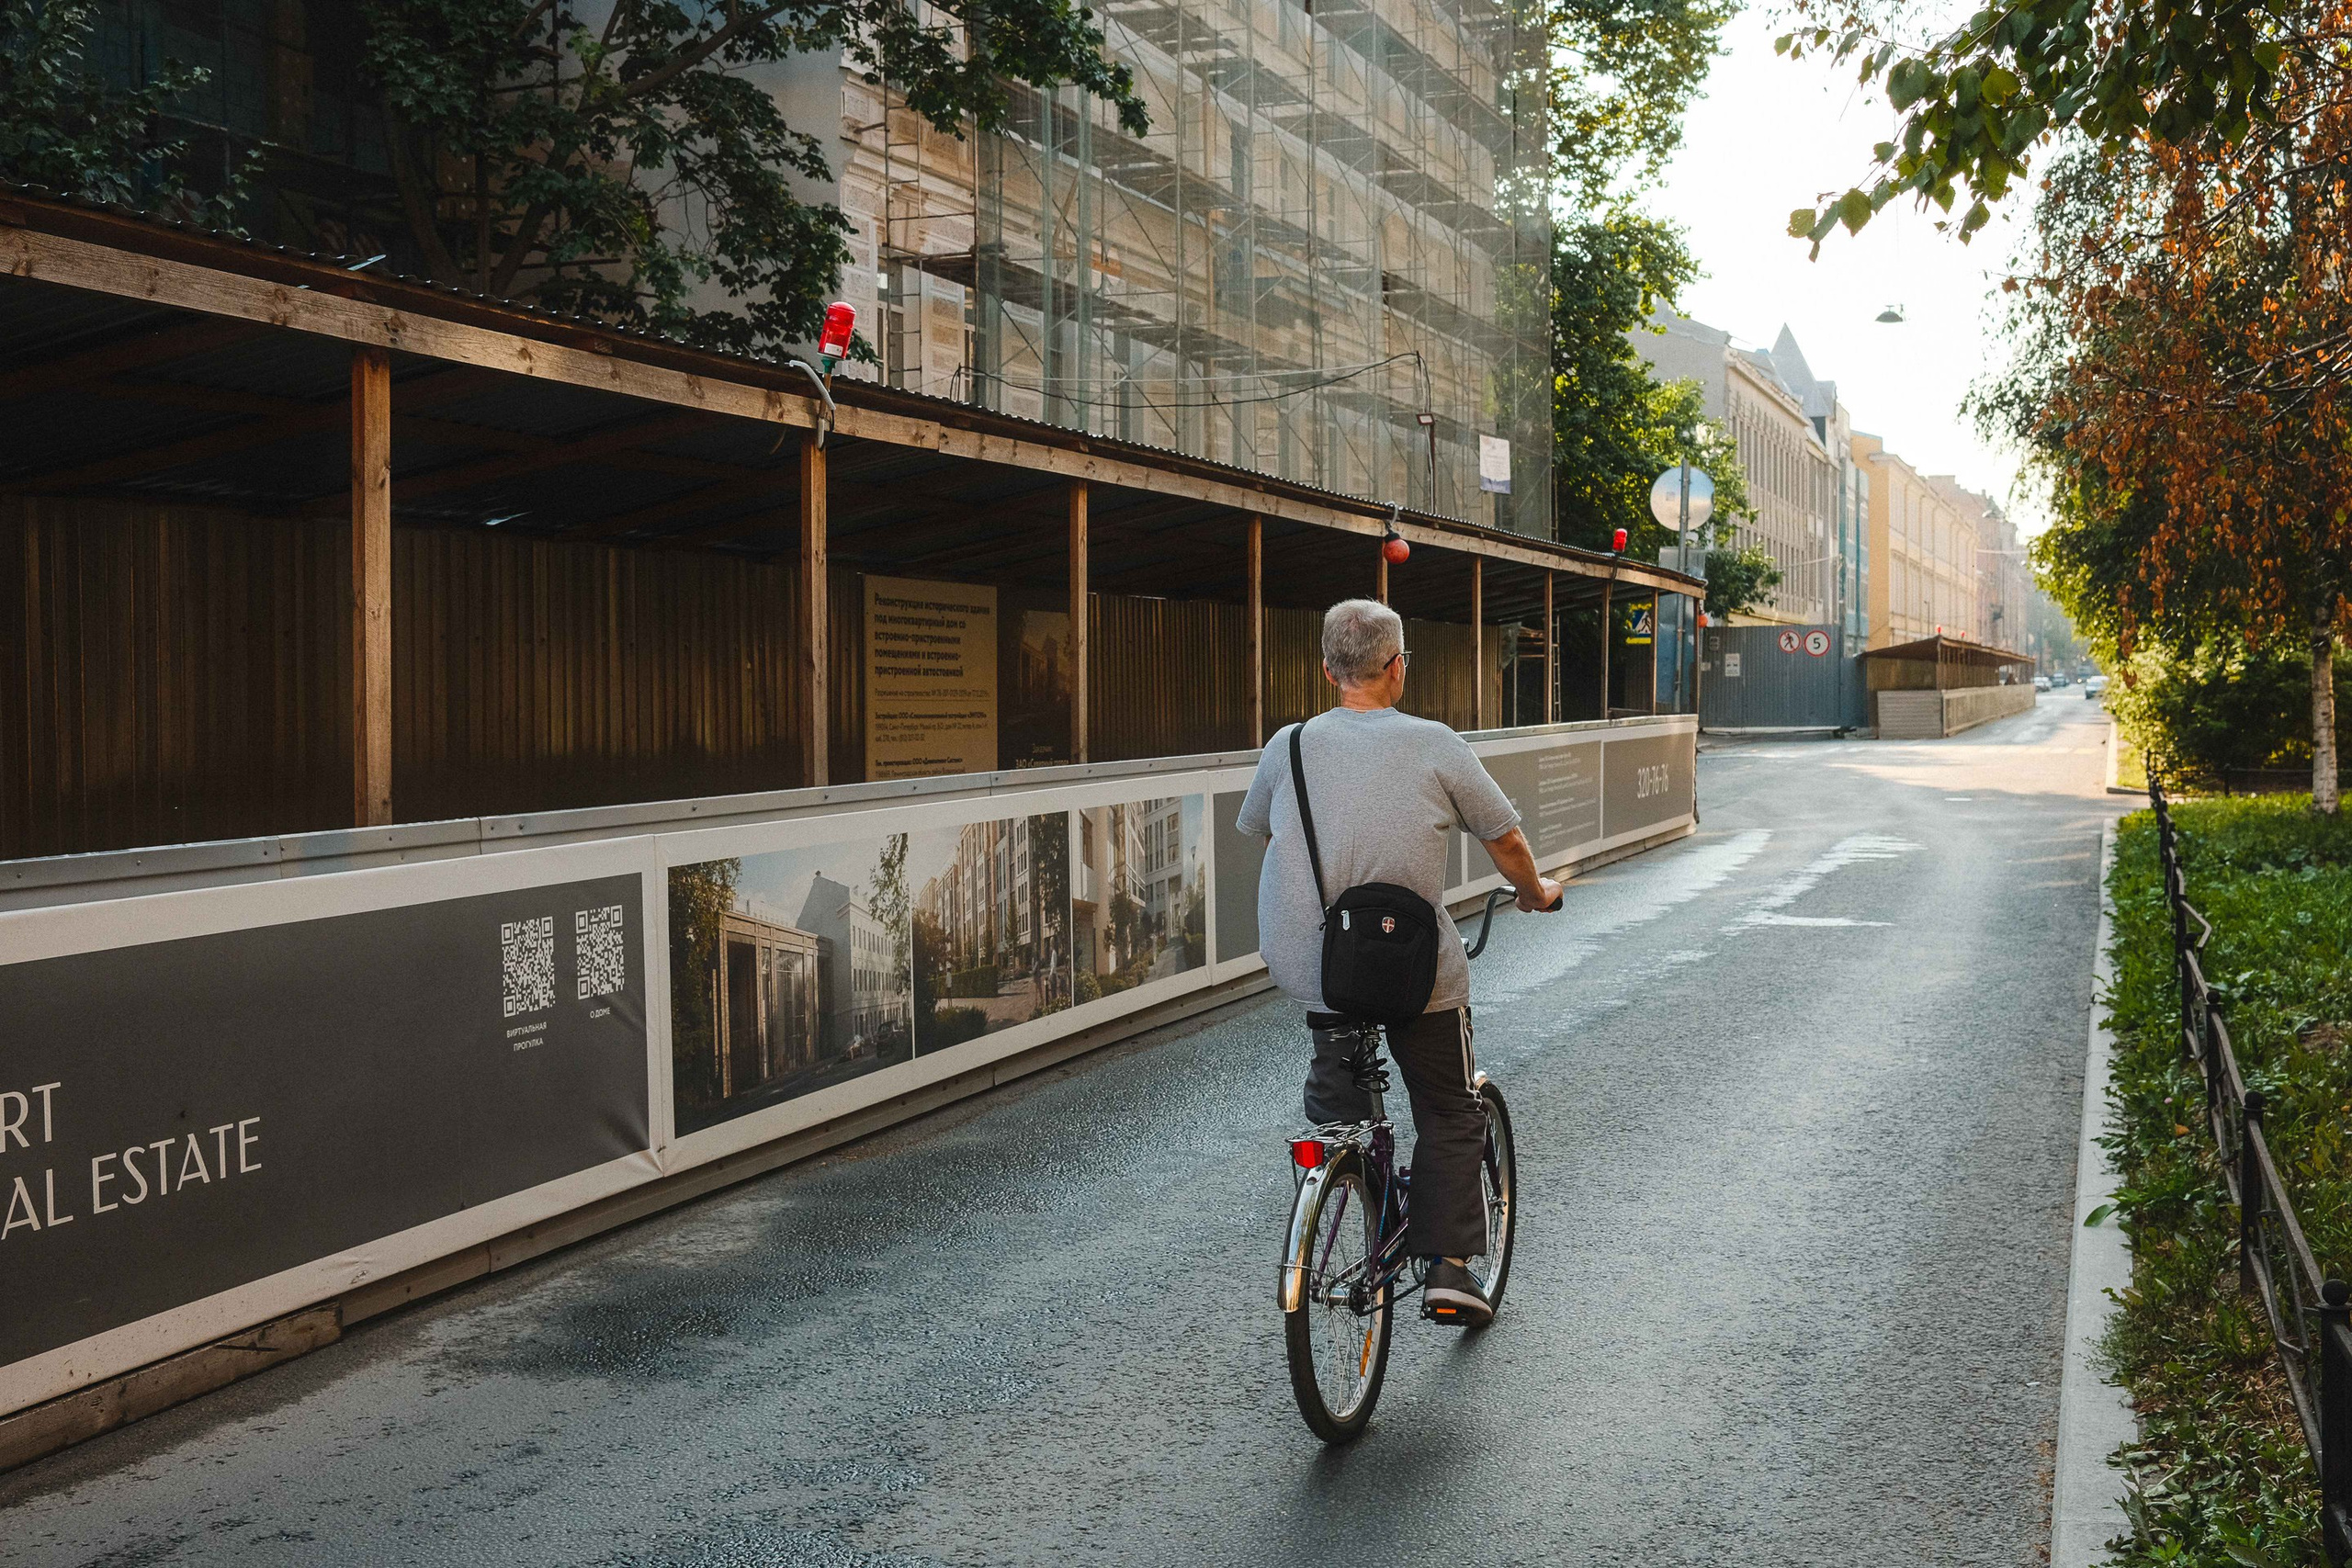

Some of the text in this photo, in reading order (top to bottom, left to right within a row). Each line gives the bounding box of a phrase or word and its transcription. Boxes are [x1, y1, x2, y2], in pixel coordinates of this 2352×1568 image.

[875, 614, 888, 625] под
[1813, 637, 1822, 649] 5
[1636, 763, 1669, 799] 320-76-76
[590, 1007, 611, 1019] О ДОМЕ
[506, 1021, 548, 1038] ВИРТУАЛЬНАЯ
[513, 1037, 544, 1052] ПРОГУЛКА
[0, 1116, 263, 1240] AL ESTATE
